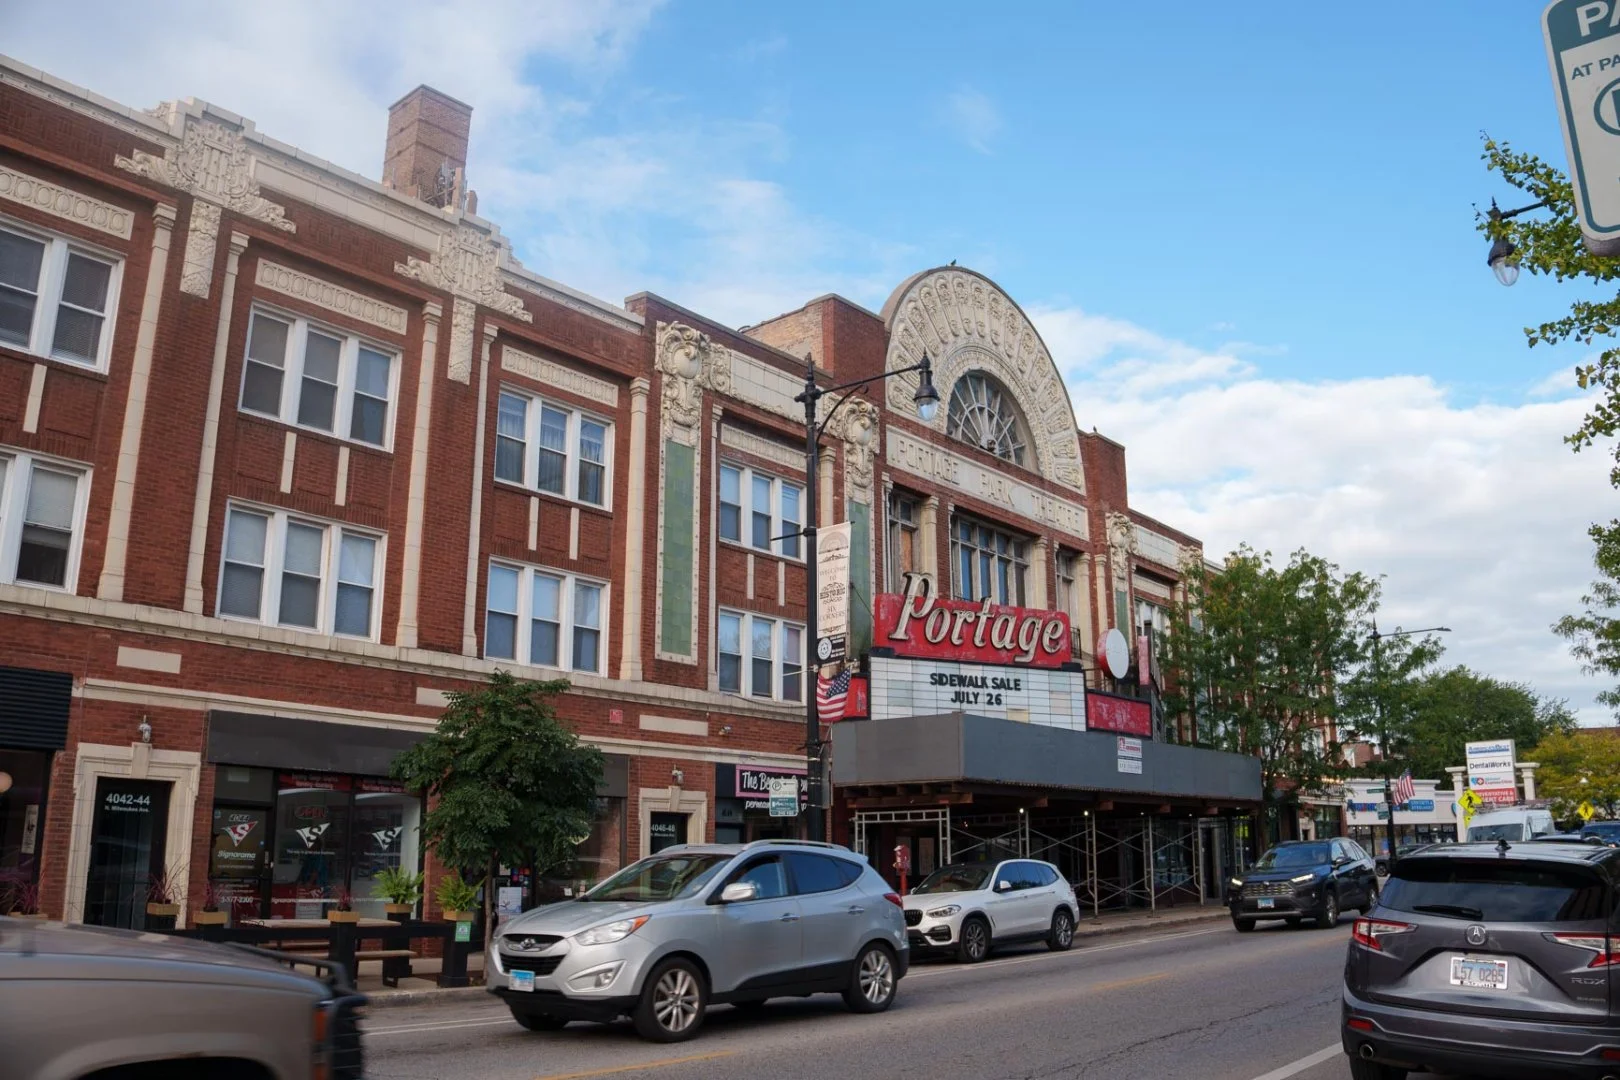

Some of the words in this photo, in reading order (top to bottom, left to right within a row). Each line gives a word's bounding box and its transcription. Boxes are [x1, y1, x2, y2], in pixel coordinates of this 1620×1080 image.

[1571, 63, 1594, 80] AT
[898, 440, 960, 485] PORTAGE
[980, 472, 1015, 507] PARK
[889, 571, 1064, 664] Portage
[929, 673, 988, 689] SIDEWALK
[991, 676, 1021, 691] SALE
[951, 690, 979, 705] JULY
[986, 692, 1003, 706] 26
[742, 771, 758, 790] The
[106, 792, 151, 805] 4042-44
[1454, 965, 1473, 980] L57
[1479, 968, 1504, 983] 0285
[1570, 977, 1606, 985] RDX
